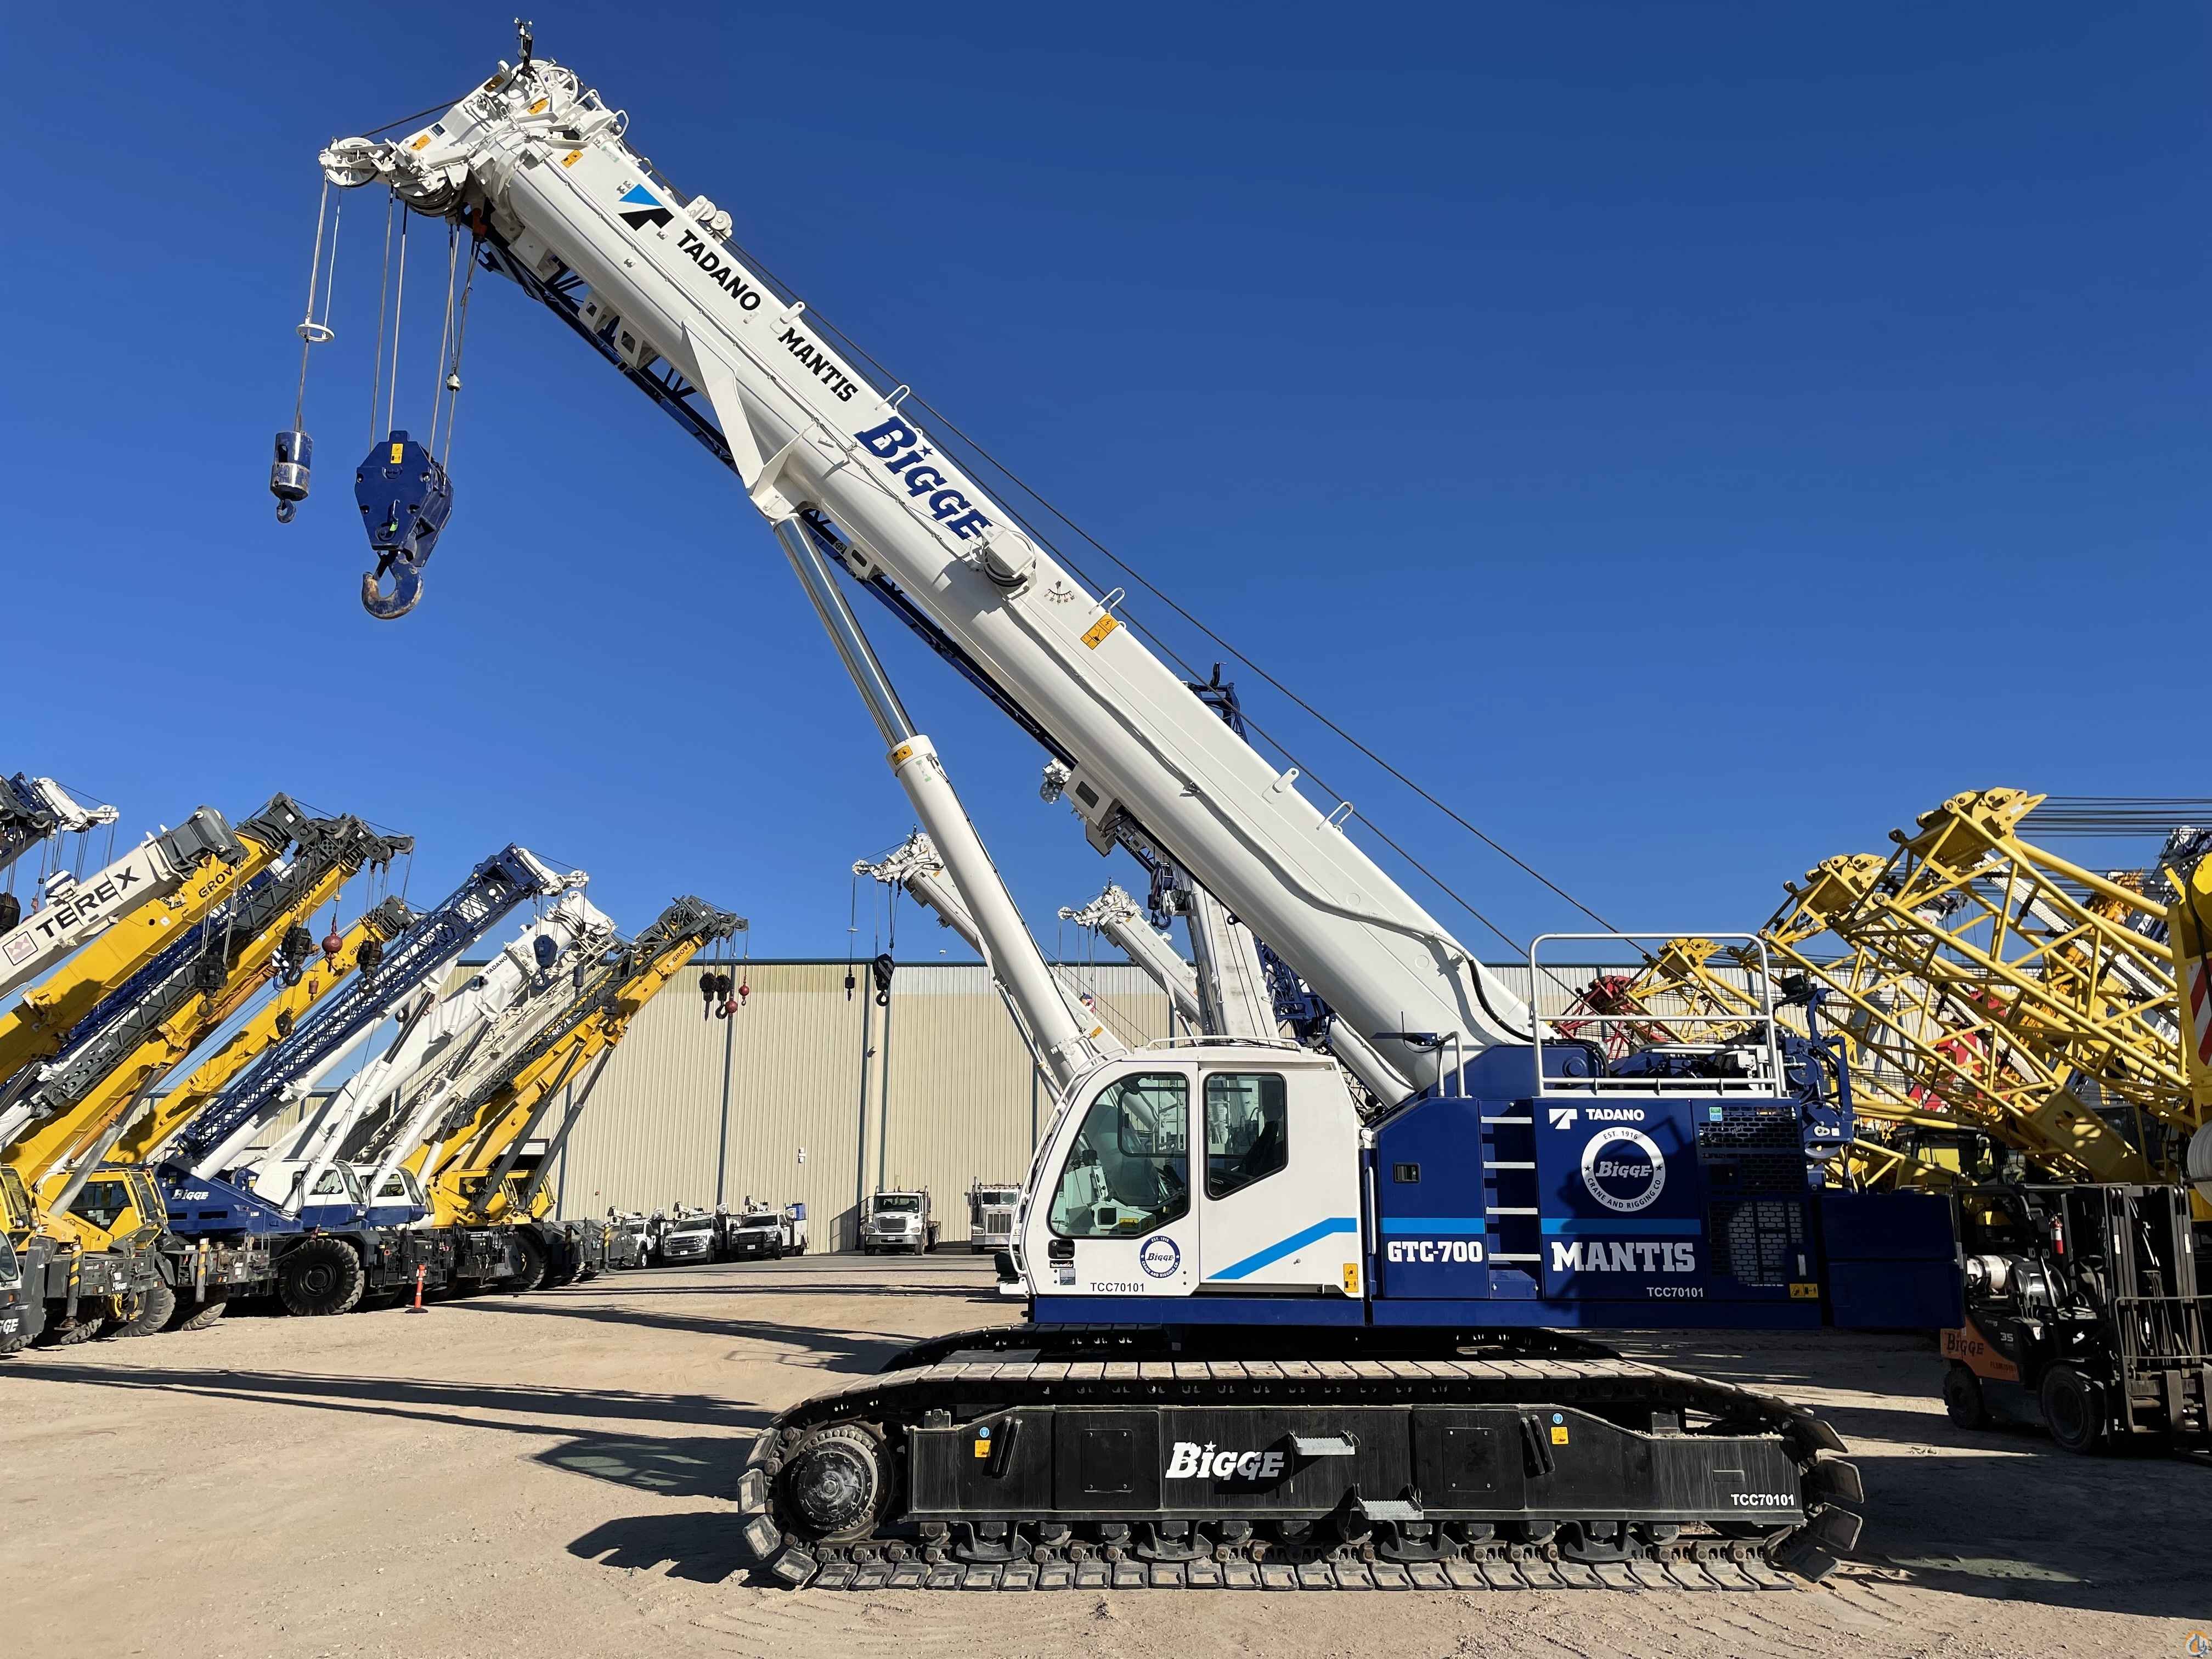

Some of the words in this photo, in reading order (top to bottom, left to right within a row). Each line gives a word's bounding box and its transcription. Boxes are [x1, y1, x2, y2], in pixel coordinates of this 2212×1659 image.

[676, 229, 761, 311] TADANO
[777, 327, 859, 402] MANTIS
[35, 866, 142, 938] TEREX
[349, 934, 373, 956] GROE
[672, 940, 693, 962] GROVE
[485, 956, 508, 975] TADANO
[1585, 1109, 1645, 1121] TADANO
[1603, 1131, 1618, 1139] EST.
[1622, 1131, 1638, 1139] 1916
[1588, 1177, 1606, 1200] CRANE
[1607, 1199, 1623, 1208] AND
[1626, 1190, 1656, 1209] RIGGING
[1654, 1177, 1662, 1190] CO.
[1387, 1241, 1483, 1262] GTC-700
[1551, 1242, 1695, 1272] MANTIS
[1090, 1283, 1144, 1292] TCC70101
[1646, 1287, 1703, 1298] TCC70101
[2000, 1332, 2014, 1342] 35
[1730, 1493, 1795, 1506] TCC70101
